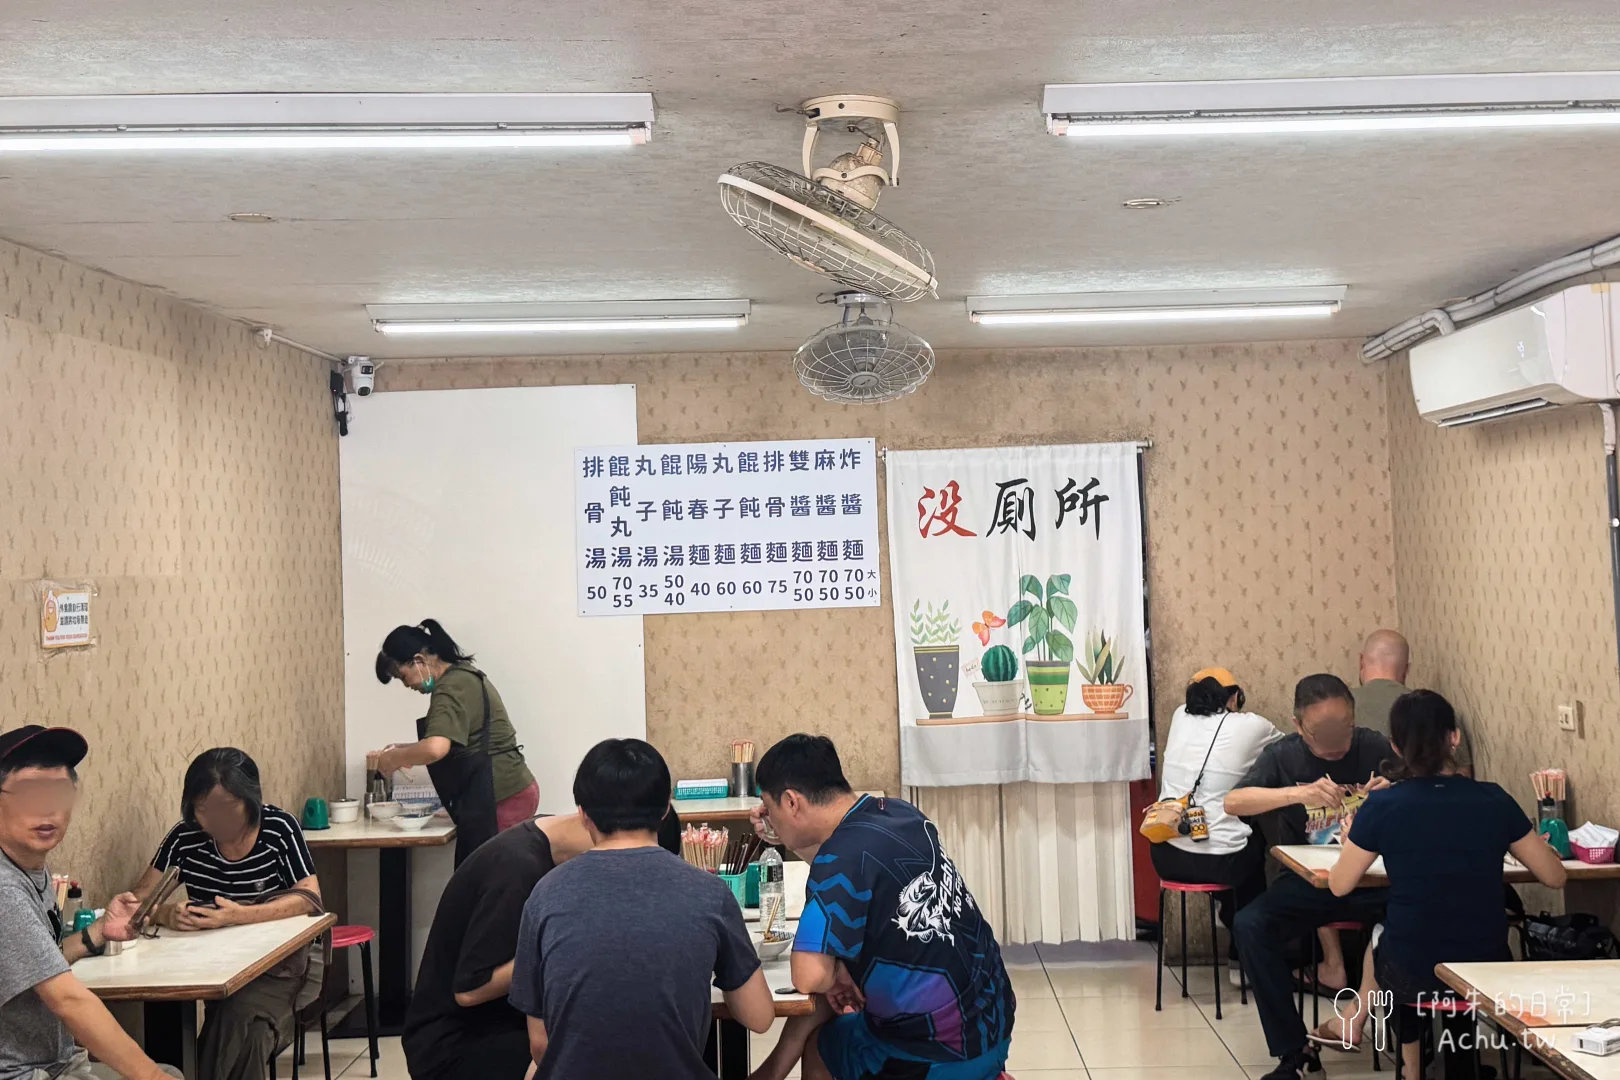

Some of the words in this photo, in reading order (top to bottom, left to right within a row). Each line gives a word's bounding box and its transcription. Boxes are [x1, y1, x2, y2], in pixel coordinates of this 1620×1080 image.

[635, 454, 658, 567] 丸子湯
[661, 453, 684, 566] 餛飩湯
[687, 453, 710, 565] 陽春麵
[713, 451, 735, 564] 丸子麵
[738, 451, 761, 564] 餛飩麵
[763, 450, 787, 563] 排骨麵
[789, 449, 812, 562] 雙醬麵
[815, 448, 838, 561] 麻醬麵
[840, 447, 863, 560] 炸醬麵
[583, 455, 606, 569] 排骨湯
[609, 455, 632, 567] 餛飩丸湯
[665, 575, 684, 588] 50
[793, 571, 812, 583] 70
[819, 570, 838, 583] 70
[844, 569, 863, 582] 70
[868, 570, 876, 579] 大
[613, 577, 632, 590] 70
[691, 583, 710, 595] 40
[717, 582, 736, 595] 60
[743, 581, 762, 594] 60
[768, 580, 787, 593] 75
[587, 586, 606, 599] 50
[639, 584, 658, 598] 35
[794, 588, 813, 601] 50
[820, 587, 839, 601] 50
[845, 586, 864, 600] 50
[868, 588, 877, 597] 小
[613, 594, 633, 608] 55
[664, 593, 684, 605] 40
